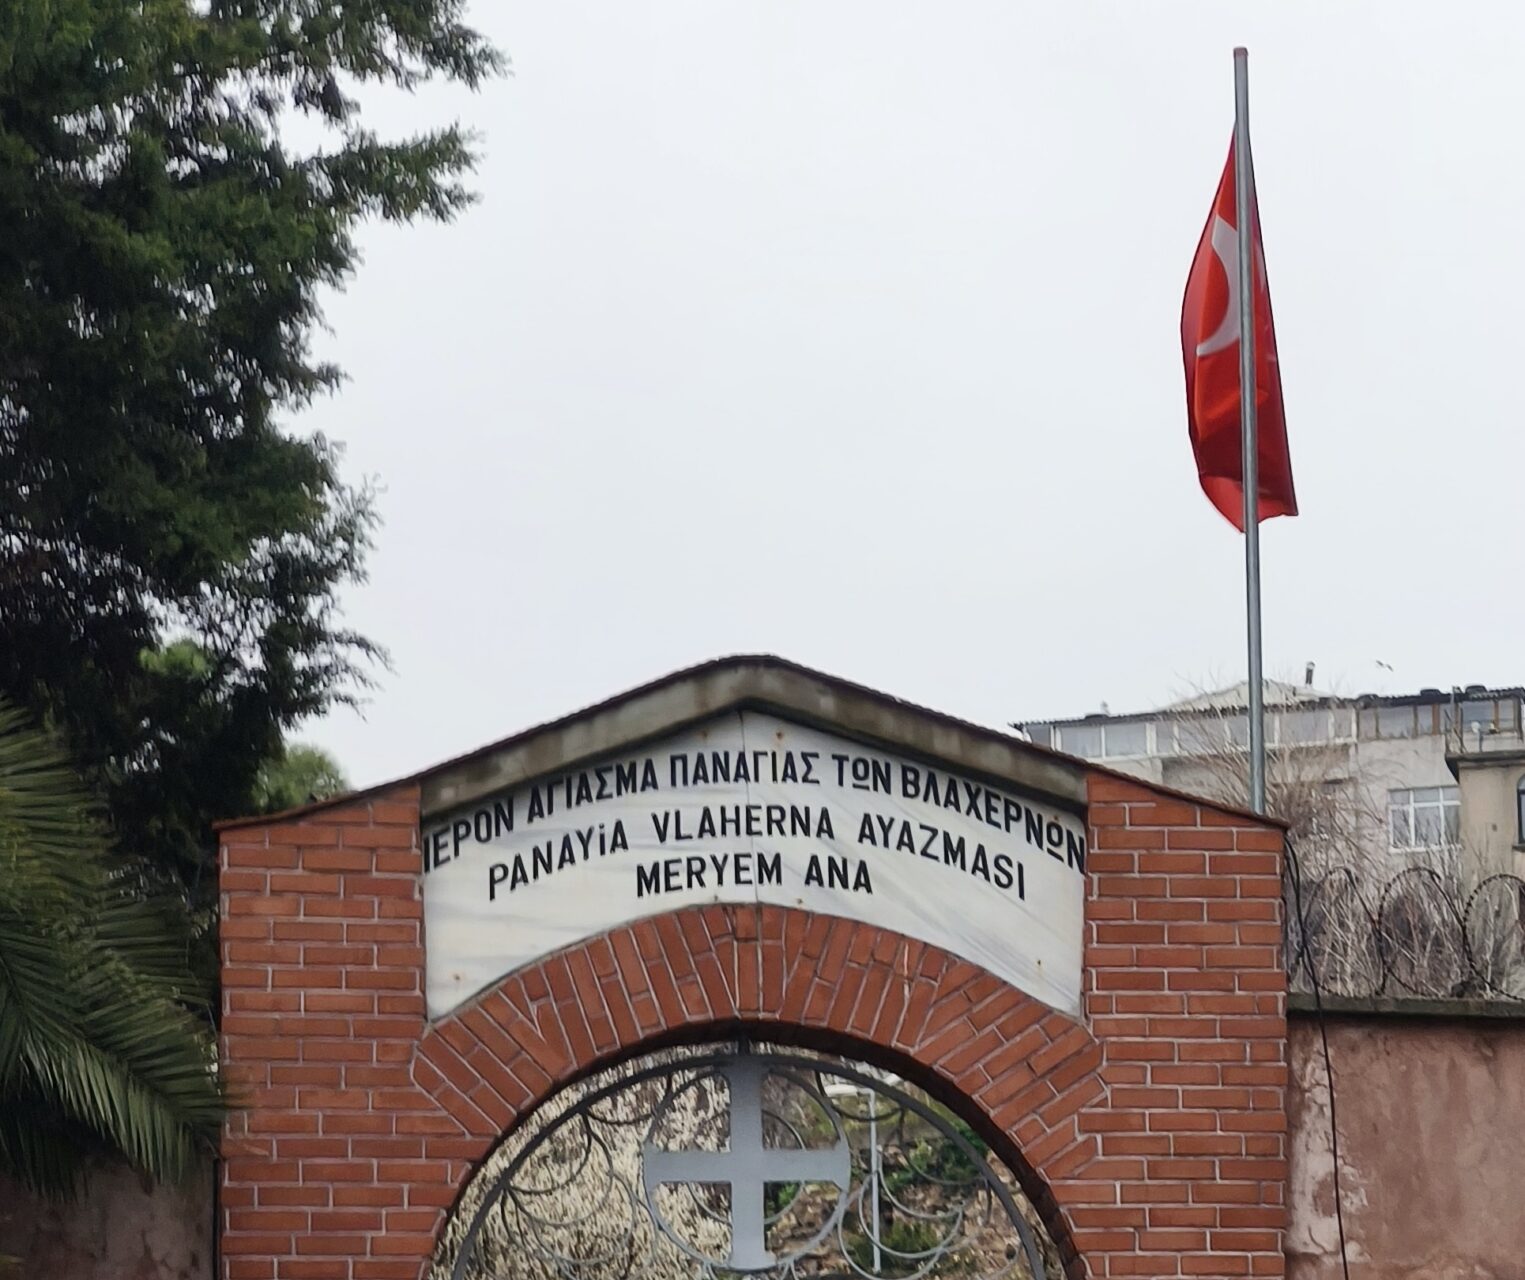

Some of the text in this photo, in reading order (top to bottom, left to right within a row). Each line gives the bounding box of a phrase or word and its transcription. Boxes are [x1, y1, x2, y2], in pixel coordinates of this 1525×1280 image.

[423, 796, 514, 875] ΙΕΡΟΝ
[527, 758, 659, 824] ΑΓΙΑΣΜΑ
[670, 750, 820, 787] ΠΑΝΑΓΙΑΣ
[651, 804, 835, 844] VLAHERNA
[857, 812, 1025, 901] AYAZMASI
[636, 852, 873, 898] MERYEM ANA
